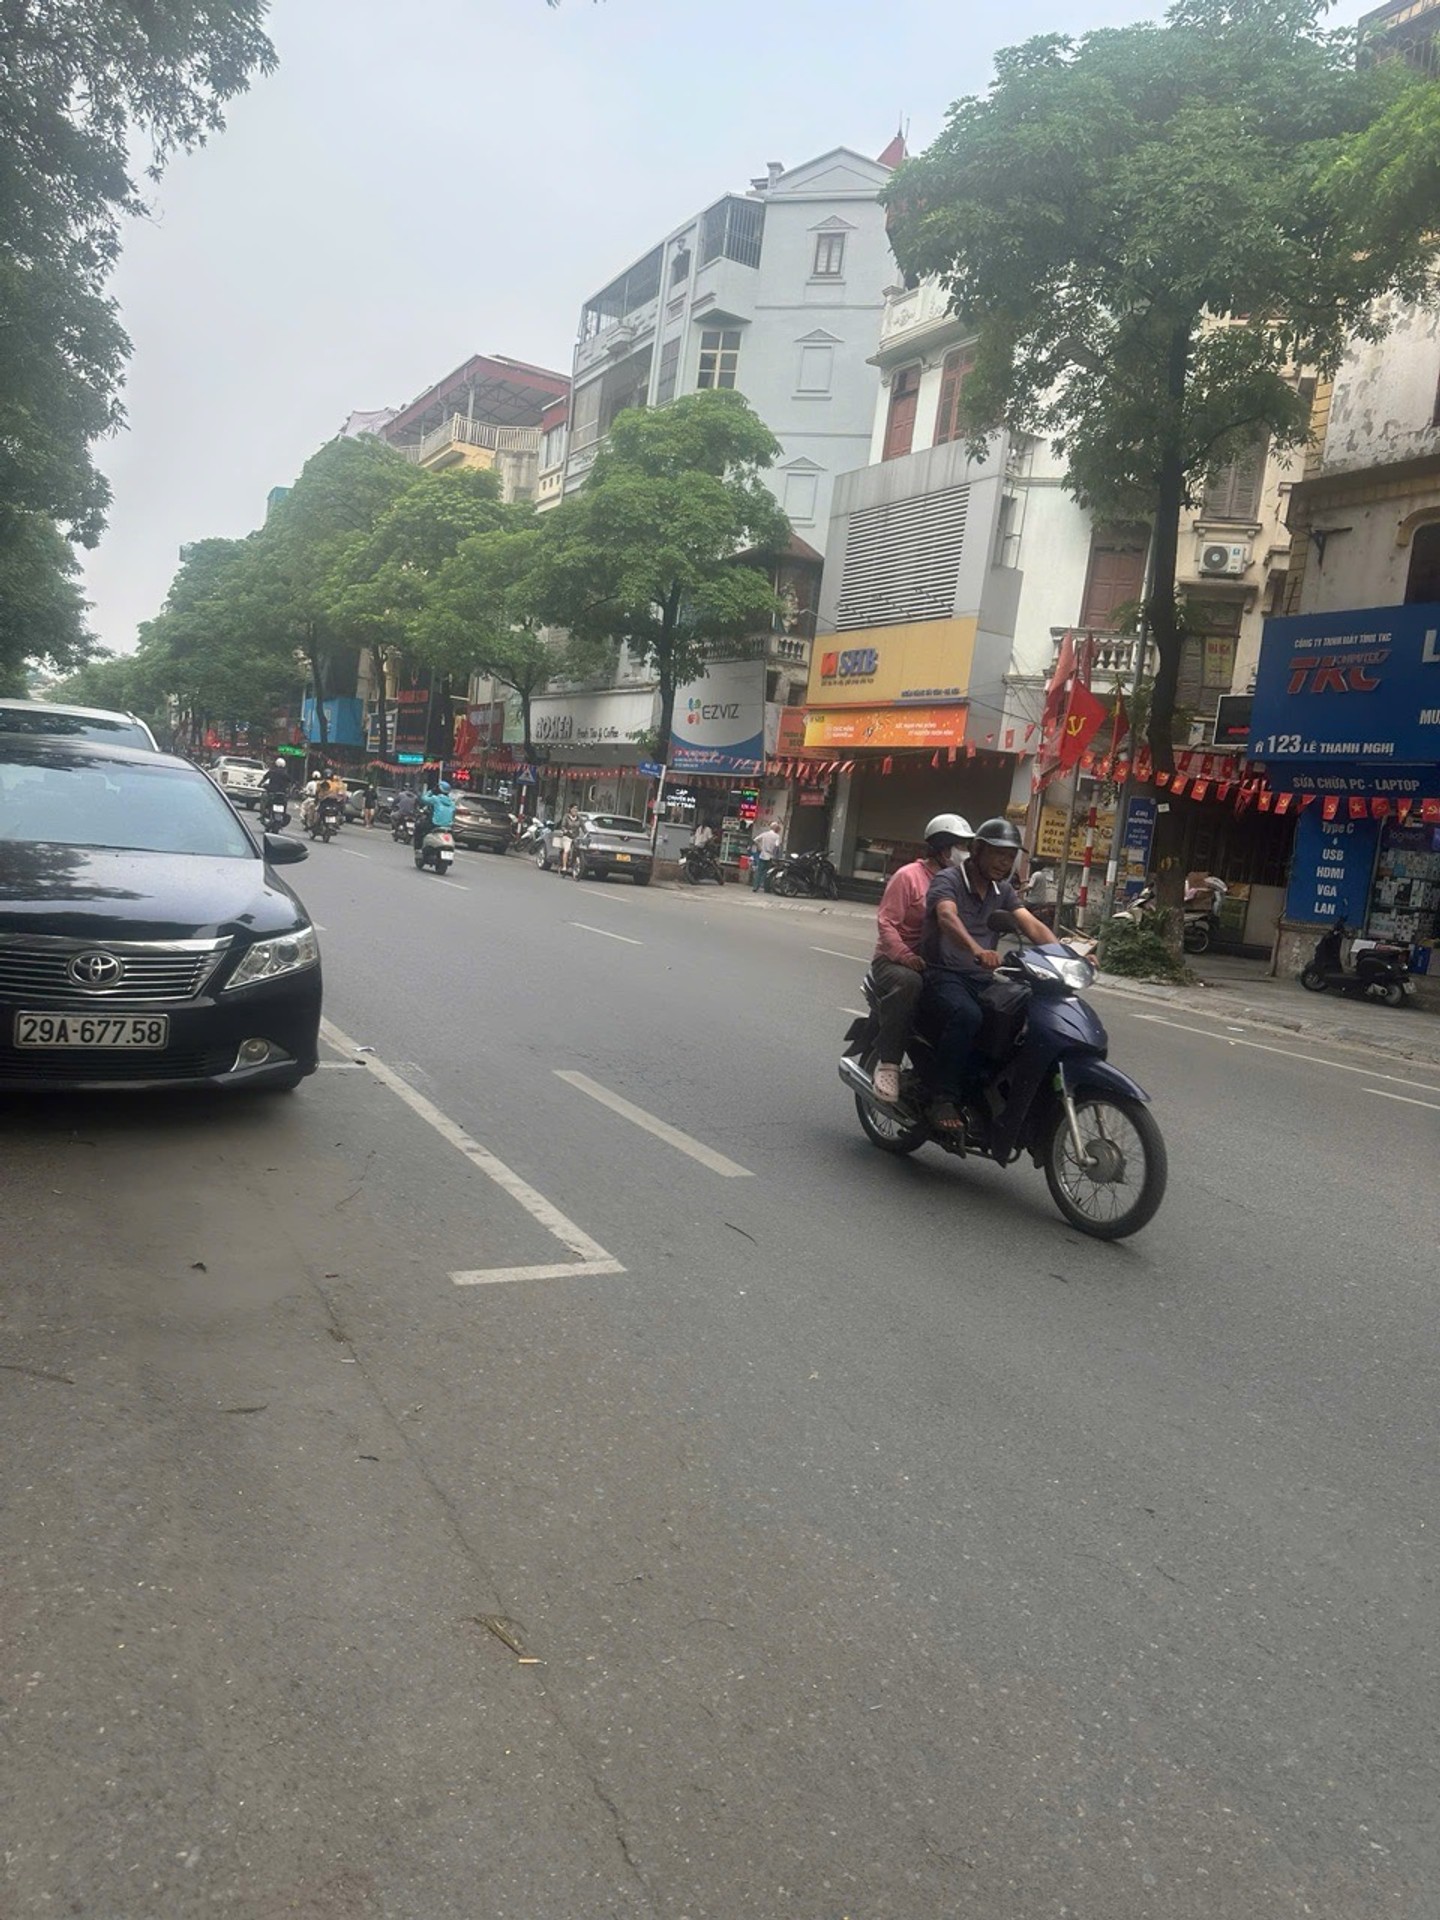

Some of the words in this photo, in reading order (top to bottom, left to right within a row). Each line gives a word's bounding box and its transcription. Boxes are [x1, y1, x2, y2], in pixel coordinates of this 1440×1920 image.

[1313, 638, 1322, 648] TY
[1287, 655, 1382, 695] TKC
[702, 703, 740, 720] EZVIZ
[1267, 735, 1302, 753] 123
[1302, 740, 1317, 753] LÊ
[1320, 742, 1359, 754] THANH
[1362, 742, 1395, 756] NGHỊ
[1292, 773, 1315, 789] SỬA
[1317, 775, 1348, 790] CHỮA
[1350, 778, 1366, 790] PC
[1375, 779, 1420, 791] LAPTOP
[1322, 821, 1345, 834] Type
[1346, 823, 1355, 834] C
[1321, 848, 1344, 861] USB
[1315, 865, 1345, 880] HDMI
[1316, 883, 1337, 897] VGA
[1313, 900, 1336, 915] LAN
[21, 1018, 162, 1045] 29A-677.58
